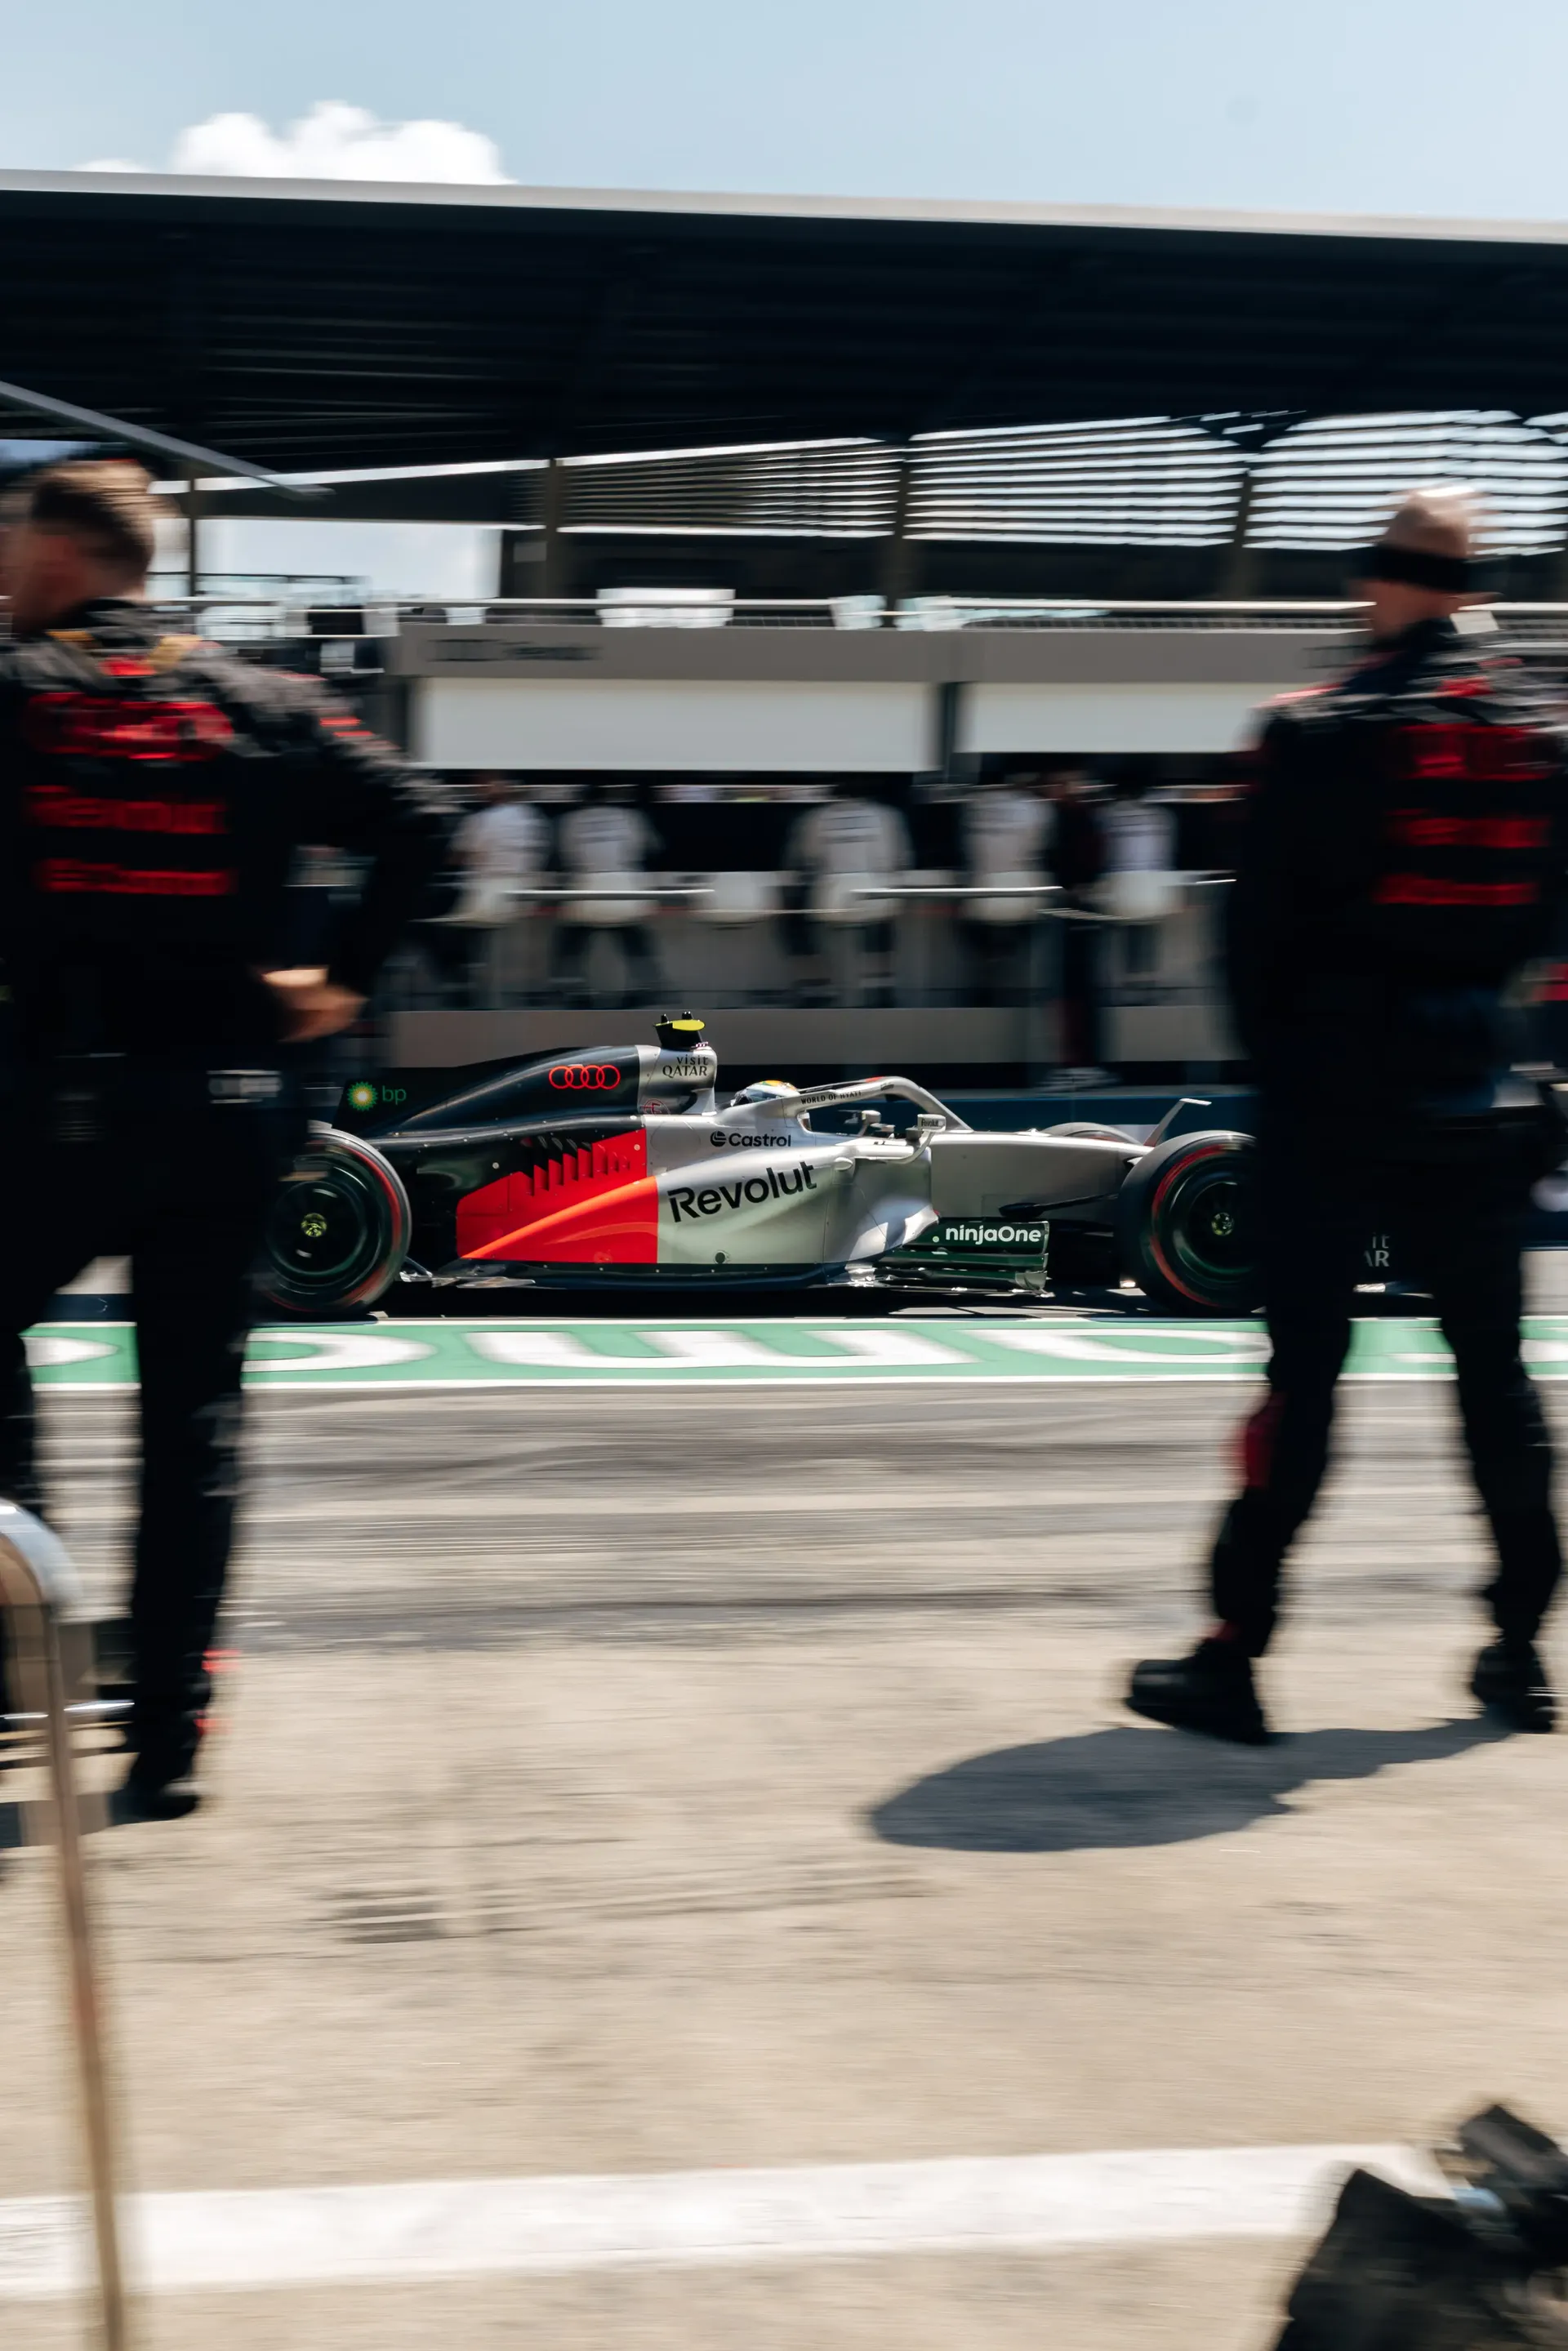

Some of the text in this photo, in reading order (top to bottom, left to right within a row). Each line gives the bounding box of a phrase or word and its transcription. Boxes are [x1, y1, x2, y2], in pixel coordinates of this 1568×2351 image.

[676, 1054, 709, 1066] visit
[662, 1065, 707, 1079] QATAR
[382, 1084, 408, 1106] bp
[801, 1095, 826, 1104] WORLD
[728, 1133, 791, 1147] Castrol
[667, 1161, 817, 1223] Revolut
[946, 1225, 1041, 1245] ninjaOne
